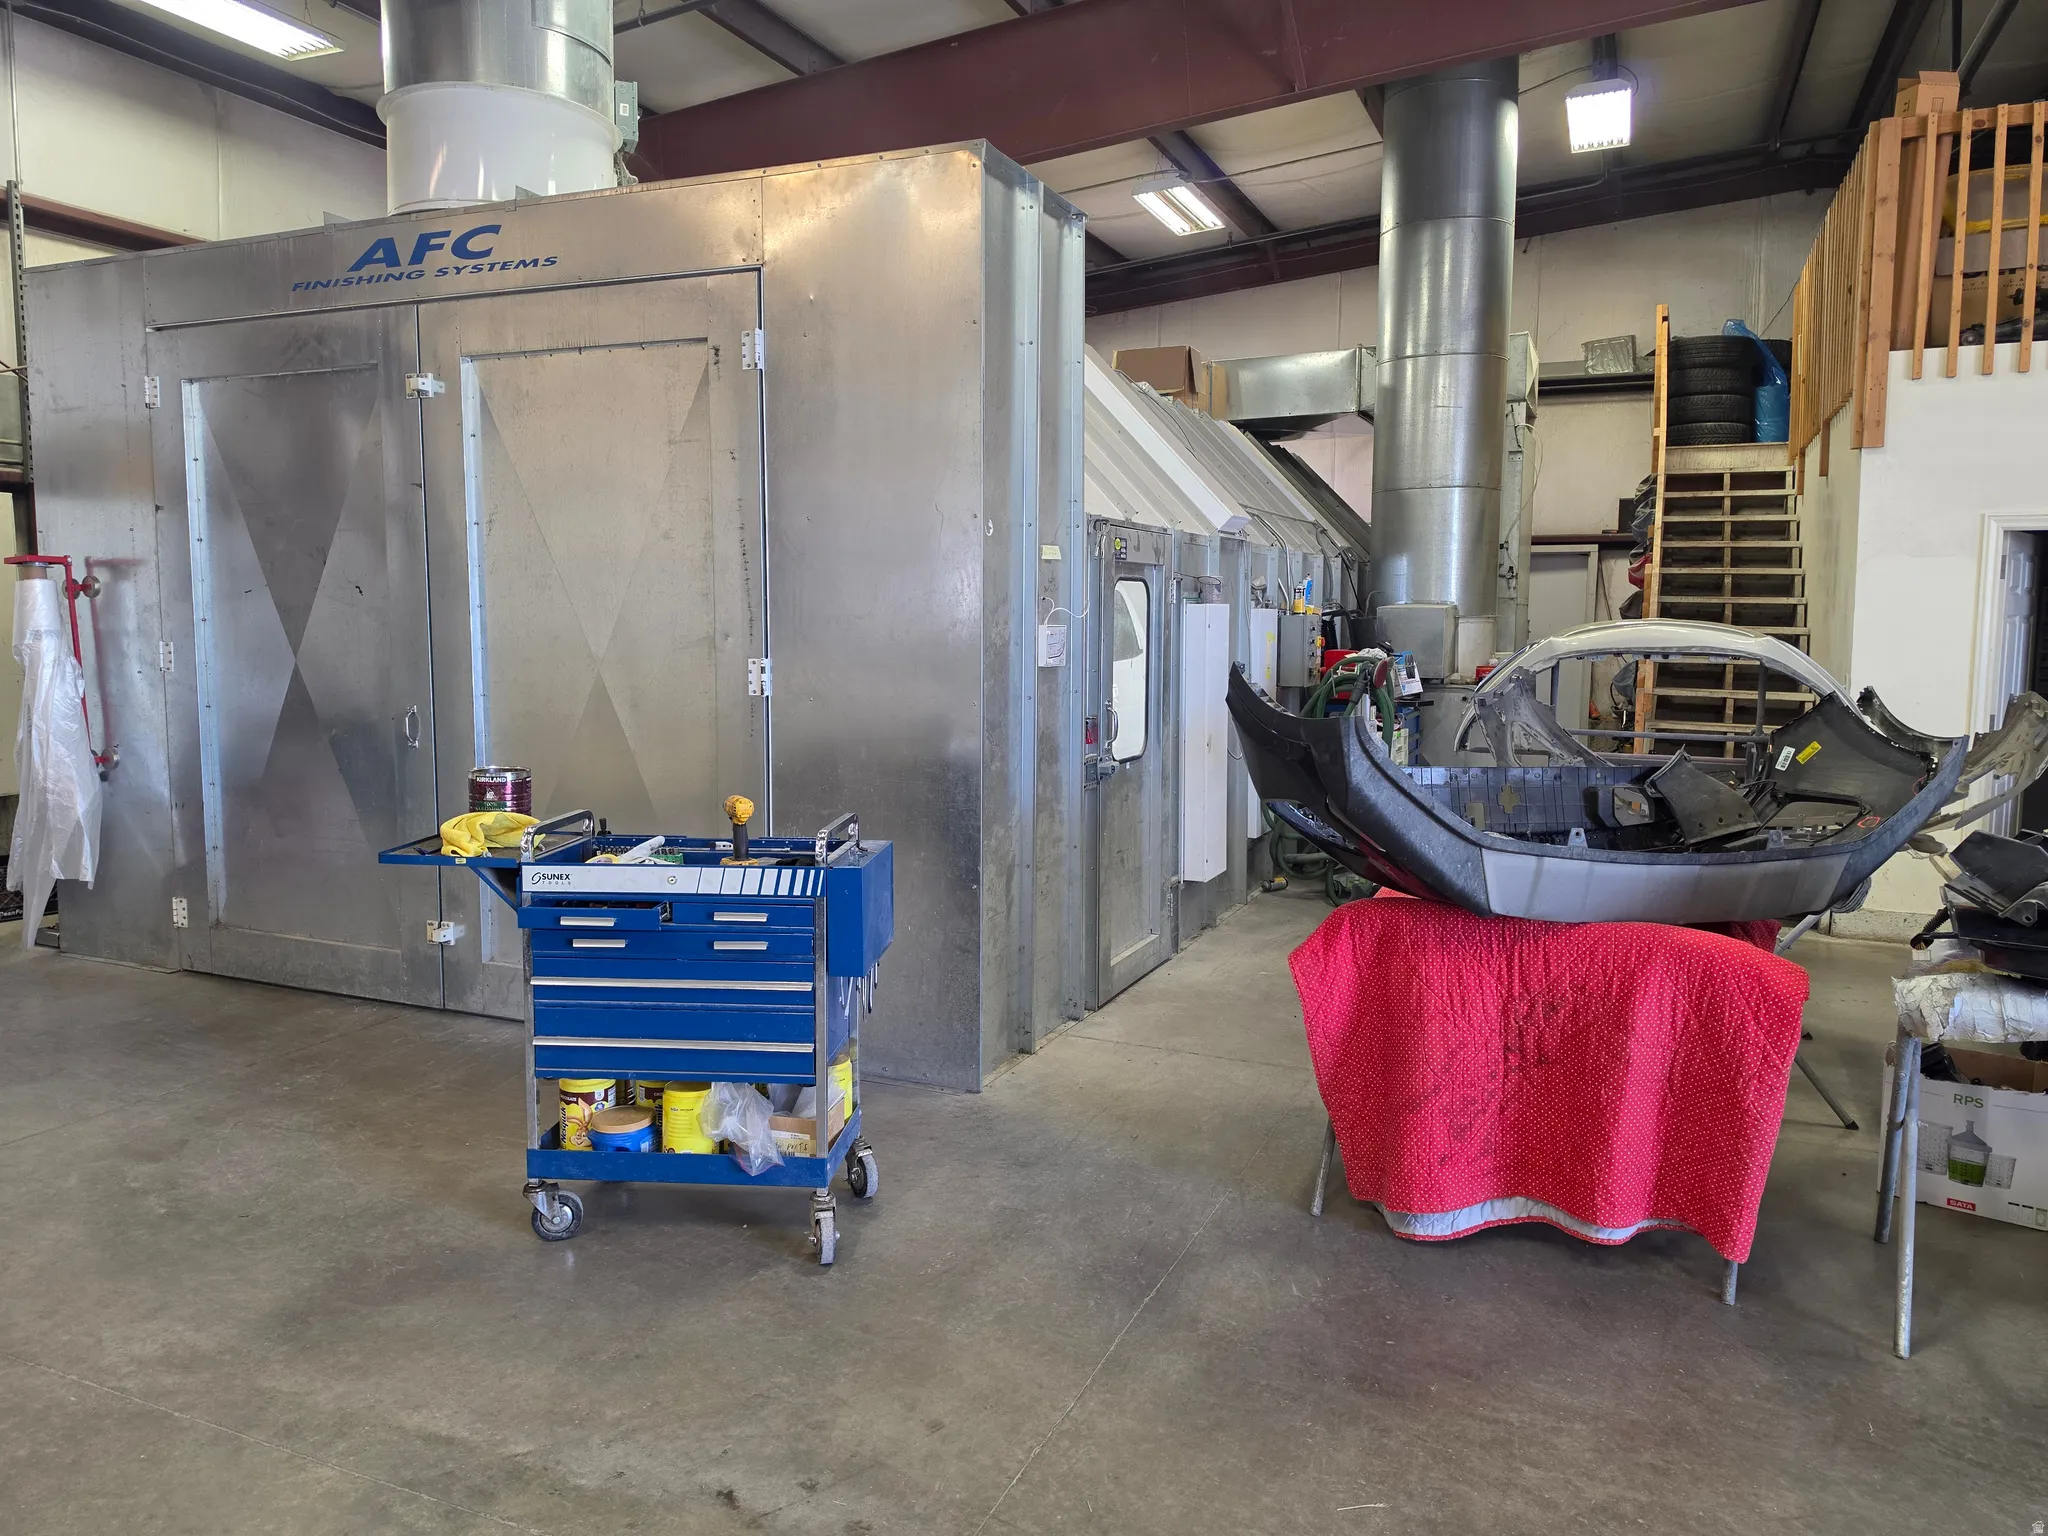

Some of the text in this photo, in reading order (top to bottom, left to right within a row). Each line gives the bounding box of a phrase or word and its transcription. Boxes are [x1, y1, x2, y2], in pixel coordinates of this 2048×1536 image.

[346, 224, 502, 272] AFC
[291, 256, 559, 292] FINISHING SYSTEMS
[541, 873, 571, 881] SUNEX
[1953, 1093, 1984, 1109] RPS
[560, 1106, 569, 1144] Nesquik
[1949, 1200, 1974, 1210] SATA
